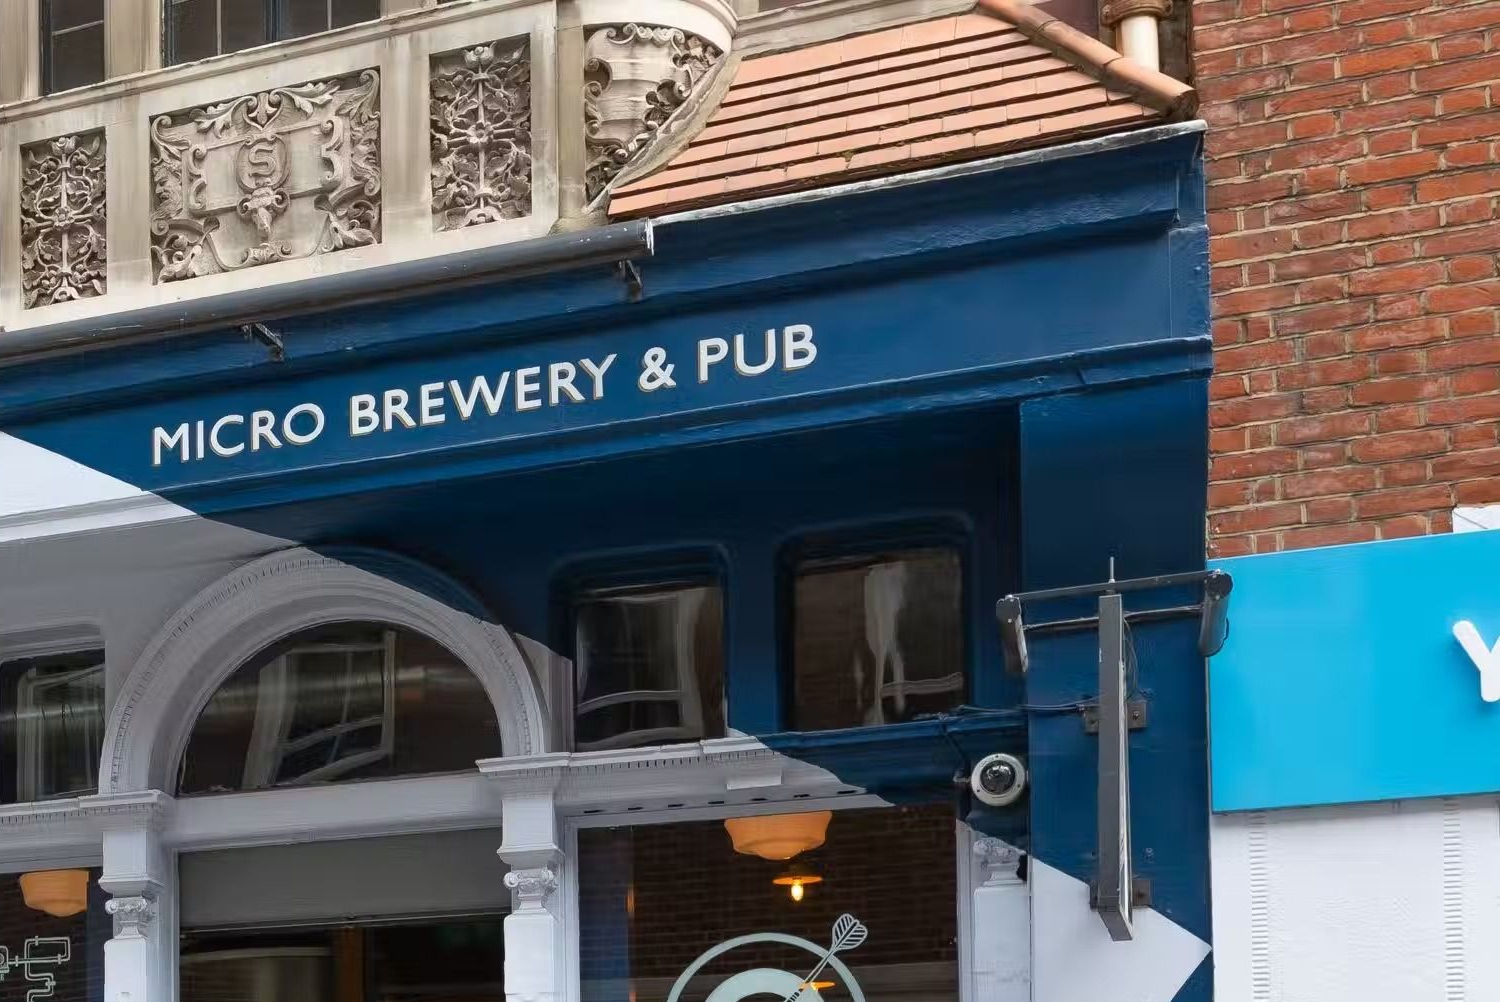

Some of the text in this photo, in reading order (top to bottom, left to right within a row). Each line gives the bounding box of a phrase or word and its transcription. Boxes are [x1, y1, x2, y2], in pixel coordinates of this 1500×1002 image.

[151, 324, 818, 466] MICRO BREWERY & PUB
